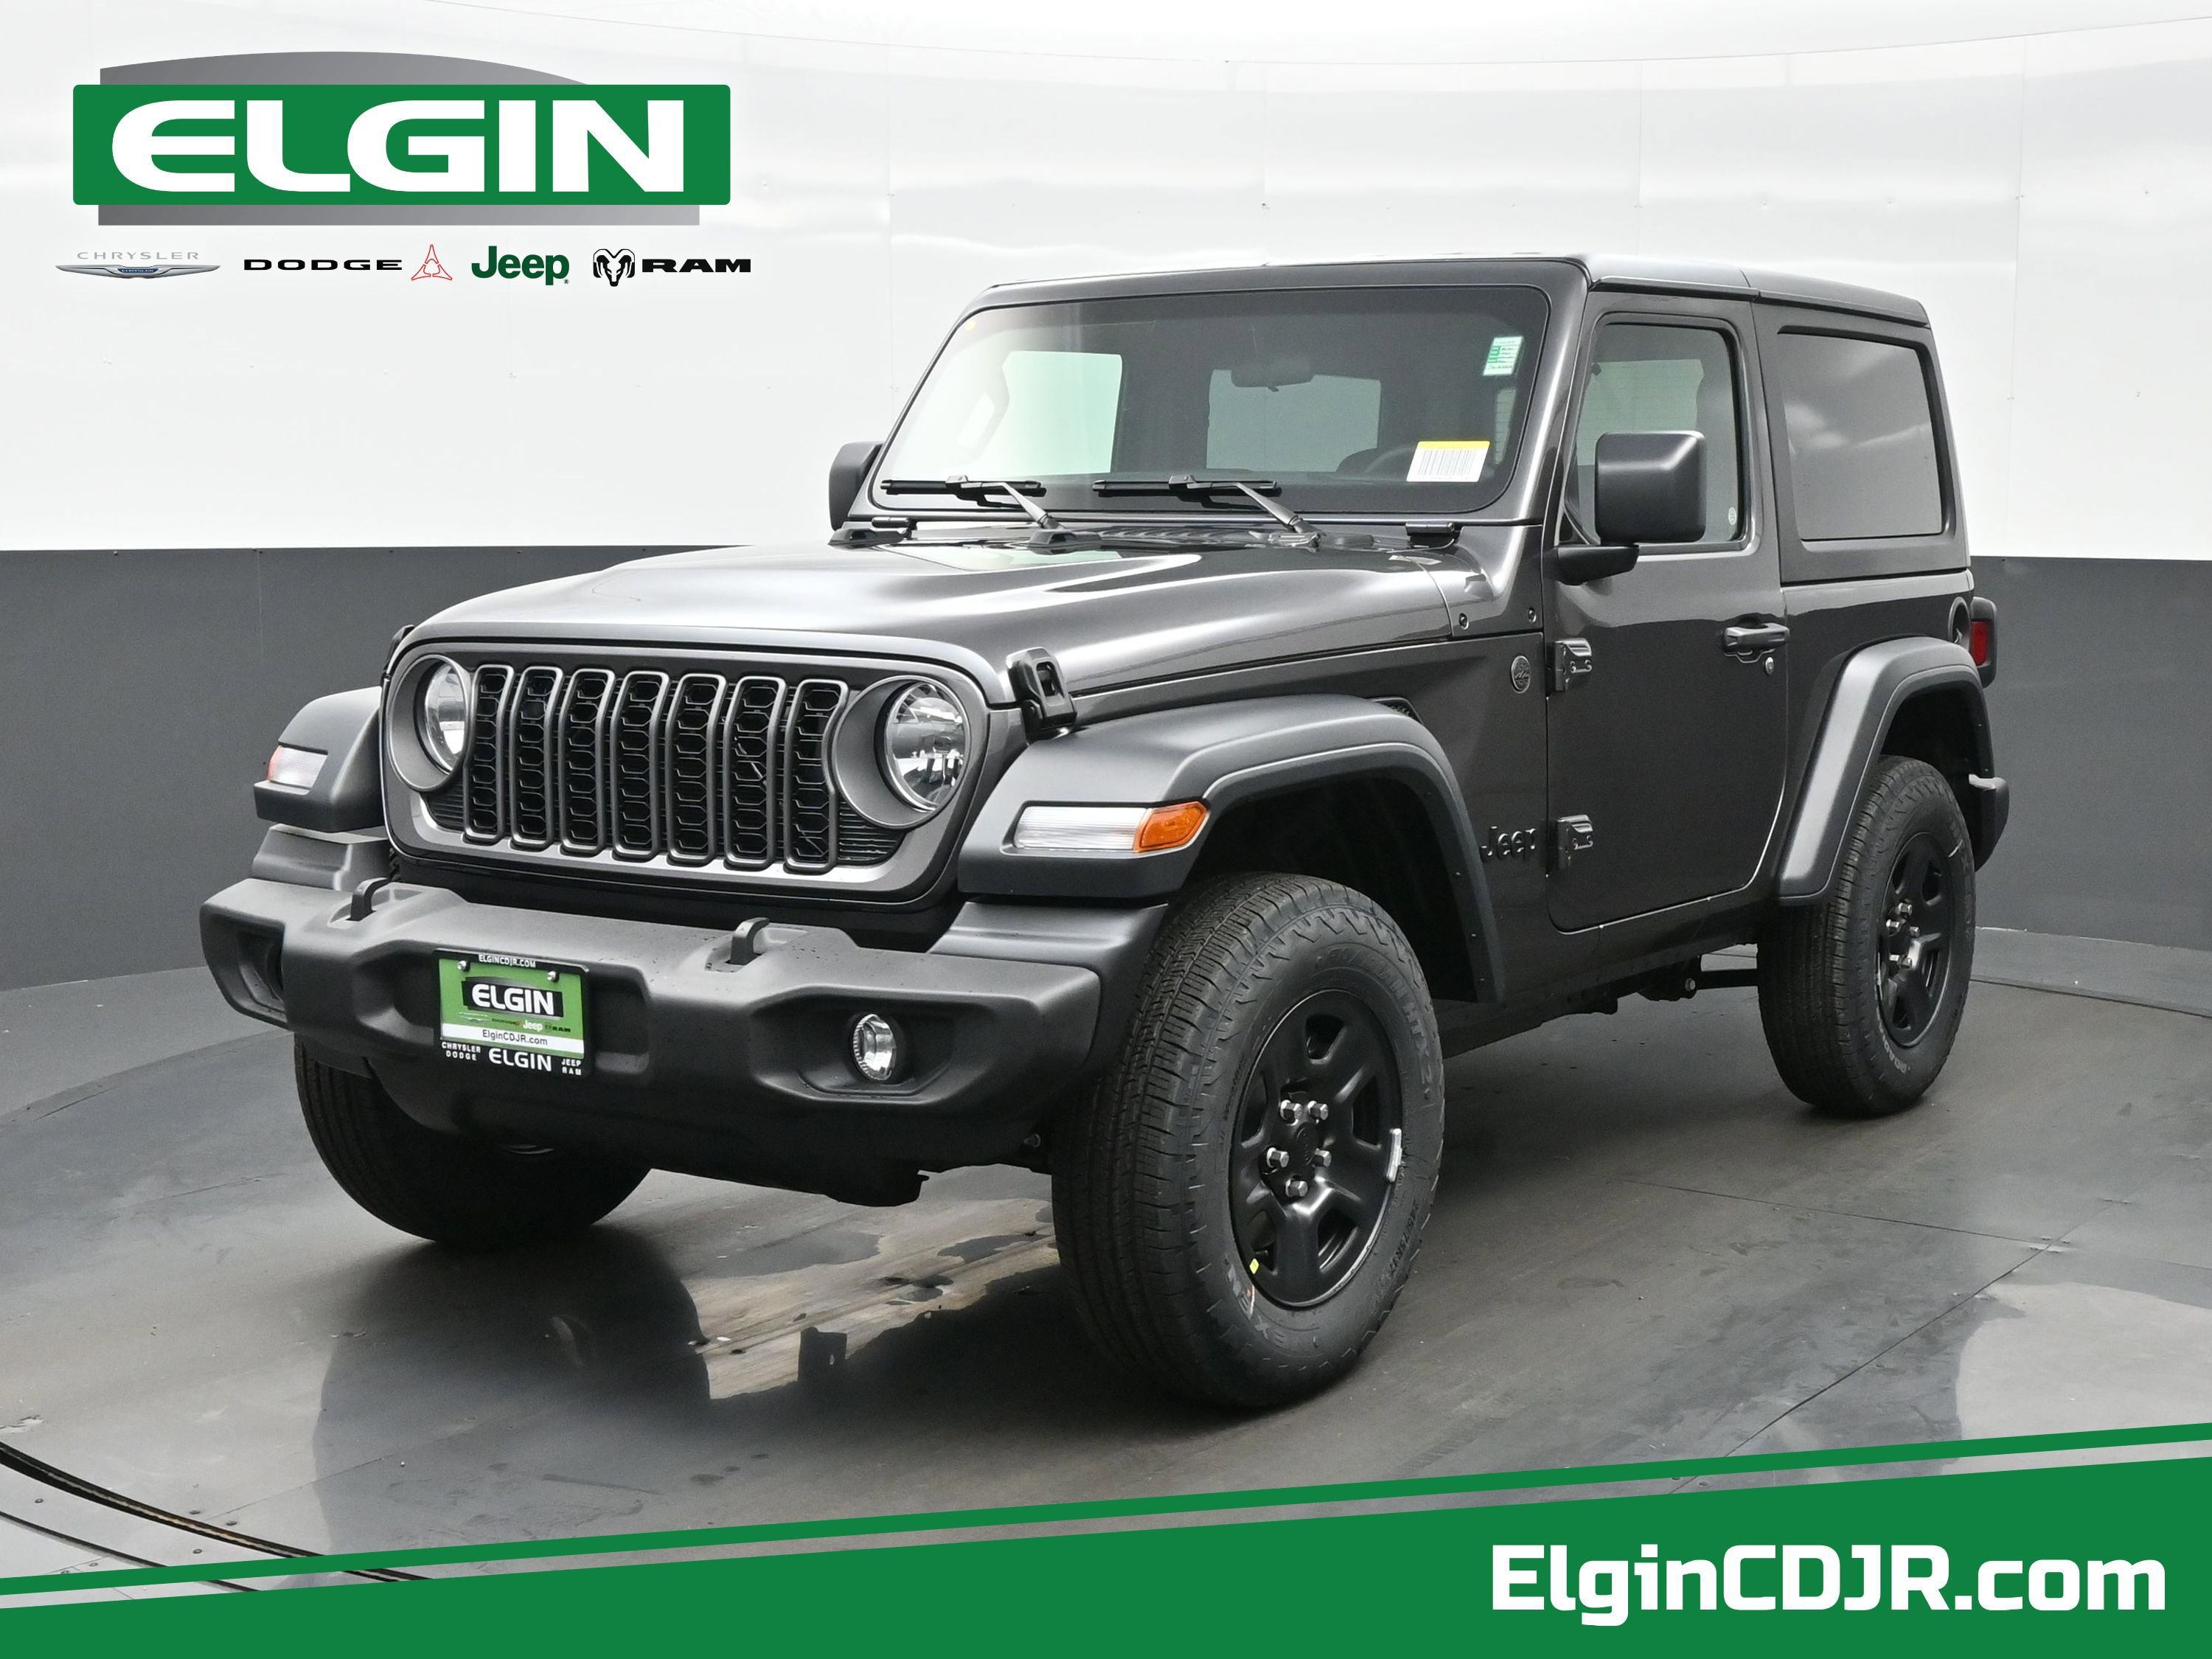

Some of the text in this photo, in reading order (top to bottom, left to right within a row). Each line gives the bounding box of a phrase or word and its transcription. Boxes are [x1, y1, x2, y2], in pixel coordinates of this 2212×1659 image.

[478, 954, 537, 968] ELGINCDJR.COM
[472, 984, 554, 1016] ELGIN
[523, 1020, 543, 1032] Jeep
[482, 1029, 549, 1046] ElginCDJR.com
[441, 1040, 481, 1054] CHRYSLER
[445, 1051, 477, 1061] DODGE
[488, 1047, 552, 1071] ELGIN
[561, 1058, 582, 1067] JEEP
[562, 1067, 582, 1076] RAM
